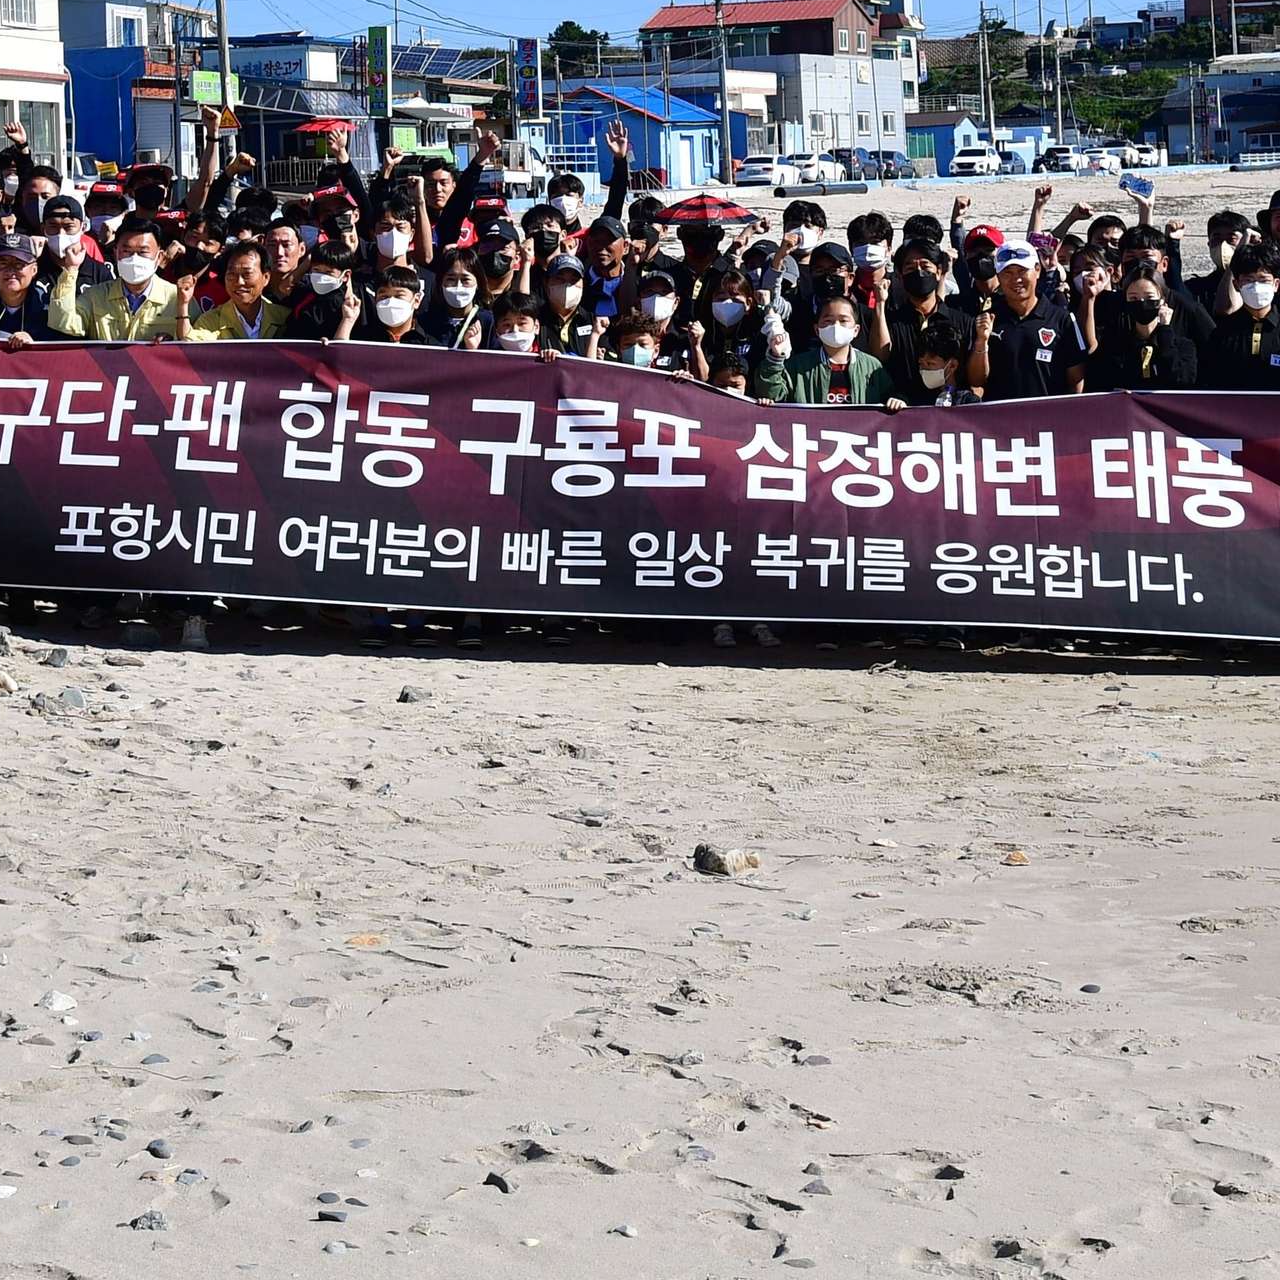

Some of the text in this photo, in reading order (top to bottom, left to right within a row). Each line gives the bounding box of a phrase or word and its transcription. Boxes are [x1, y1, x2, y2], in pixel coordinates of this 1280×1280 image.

[279, 382, 436, 488] 합동
[459, 398, 707, 497] 구룡포
[736, 422, 1060, 517] 삼정해변
[1090, 430, 1254, 529] 태풍
[54, 502, 1204, 605] 포항시민 여러분의 빠른 일상 복귀를 응원합니다.
